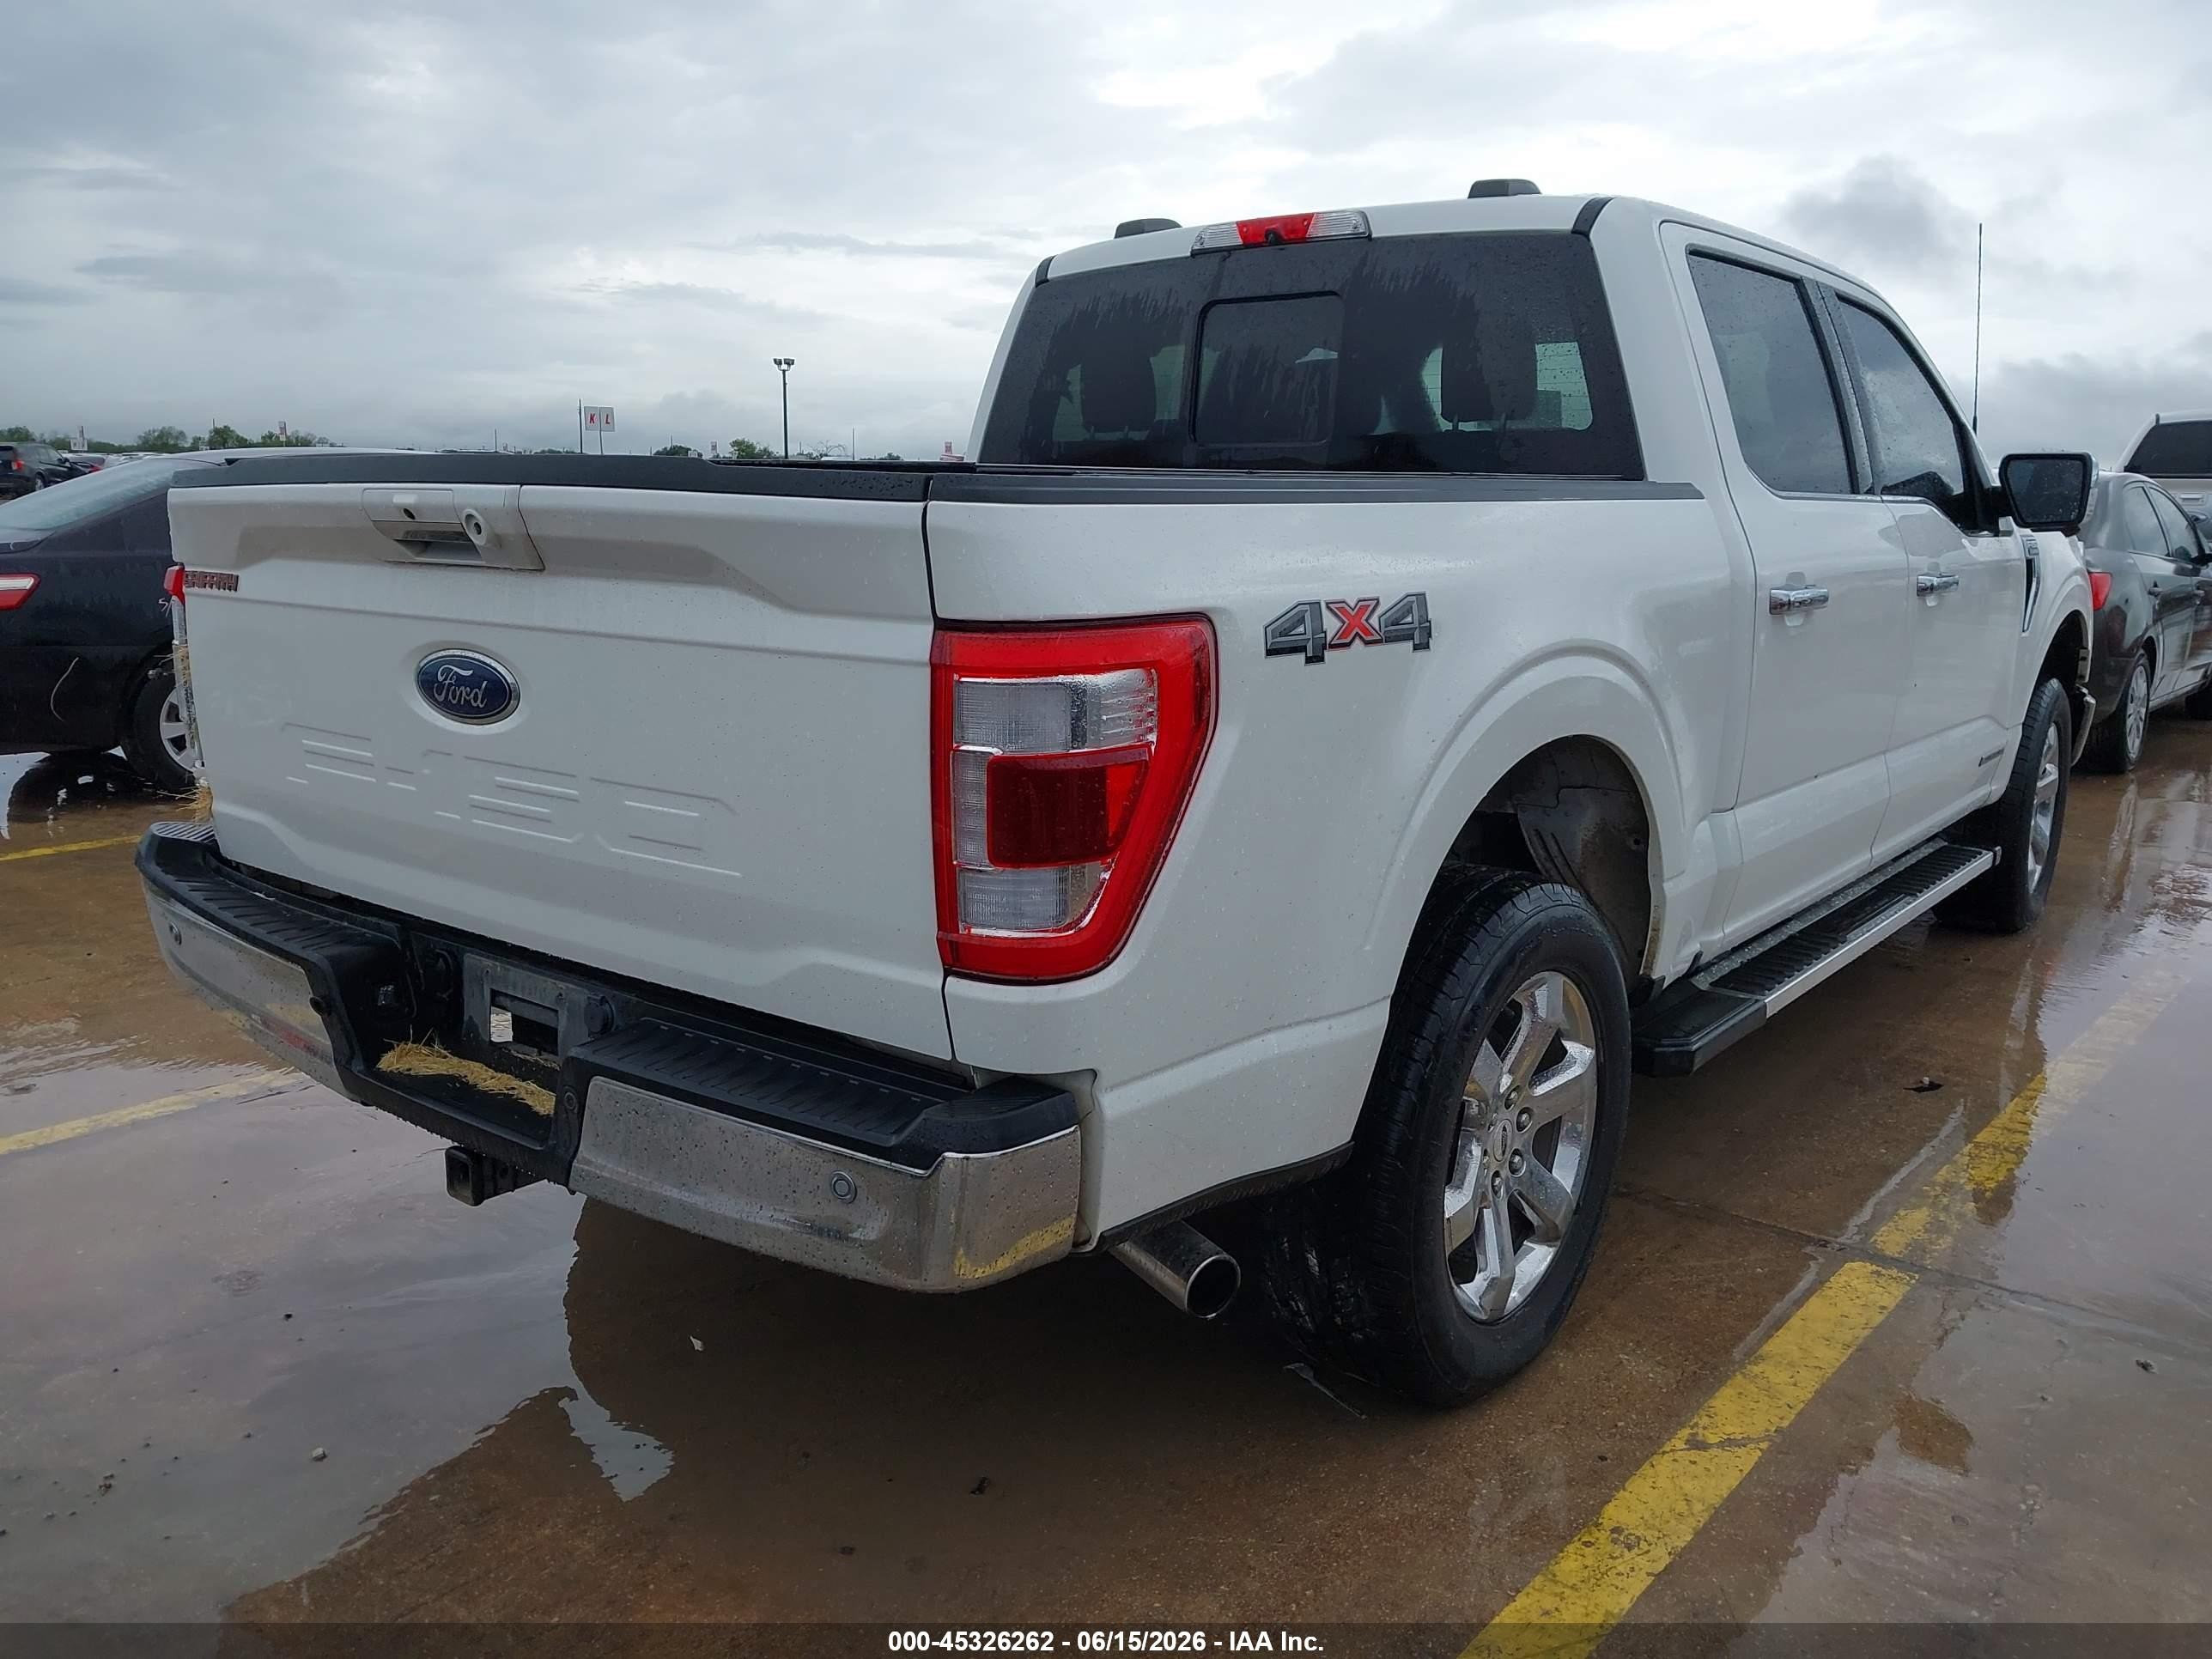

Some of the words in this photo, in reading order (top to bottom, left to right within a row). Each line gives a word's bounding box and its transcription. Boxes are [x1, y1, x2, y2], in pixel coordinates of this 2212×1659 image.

[589, 413, 597, 424] K
[605, 413, 611, 425] L
[433, 664, 489, 708] Ford
